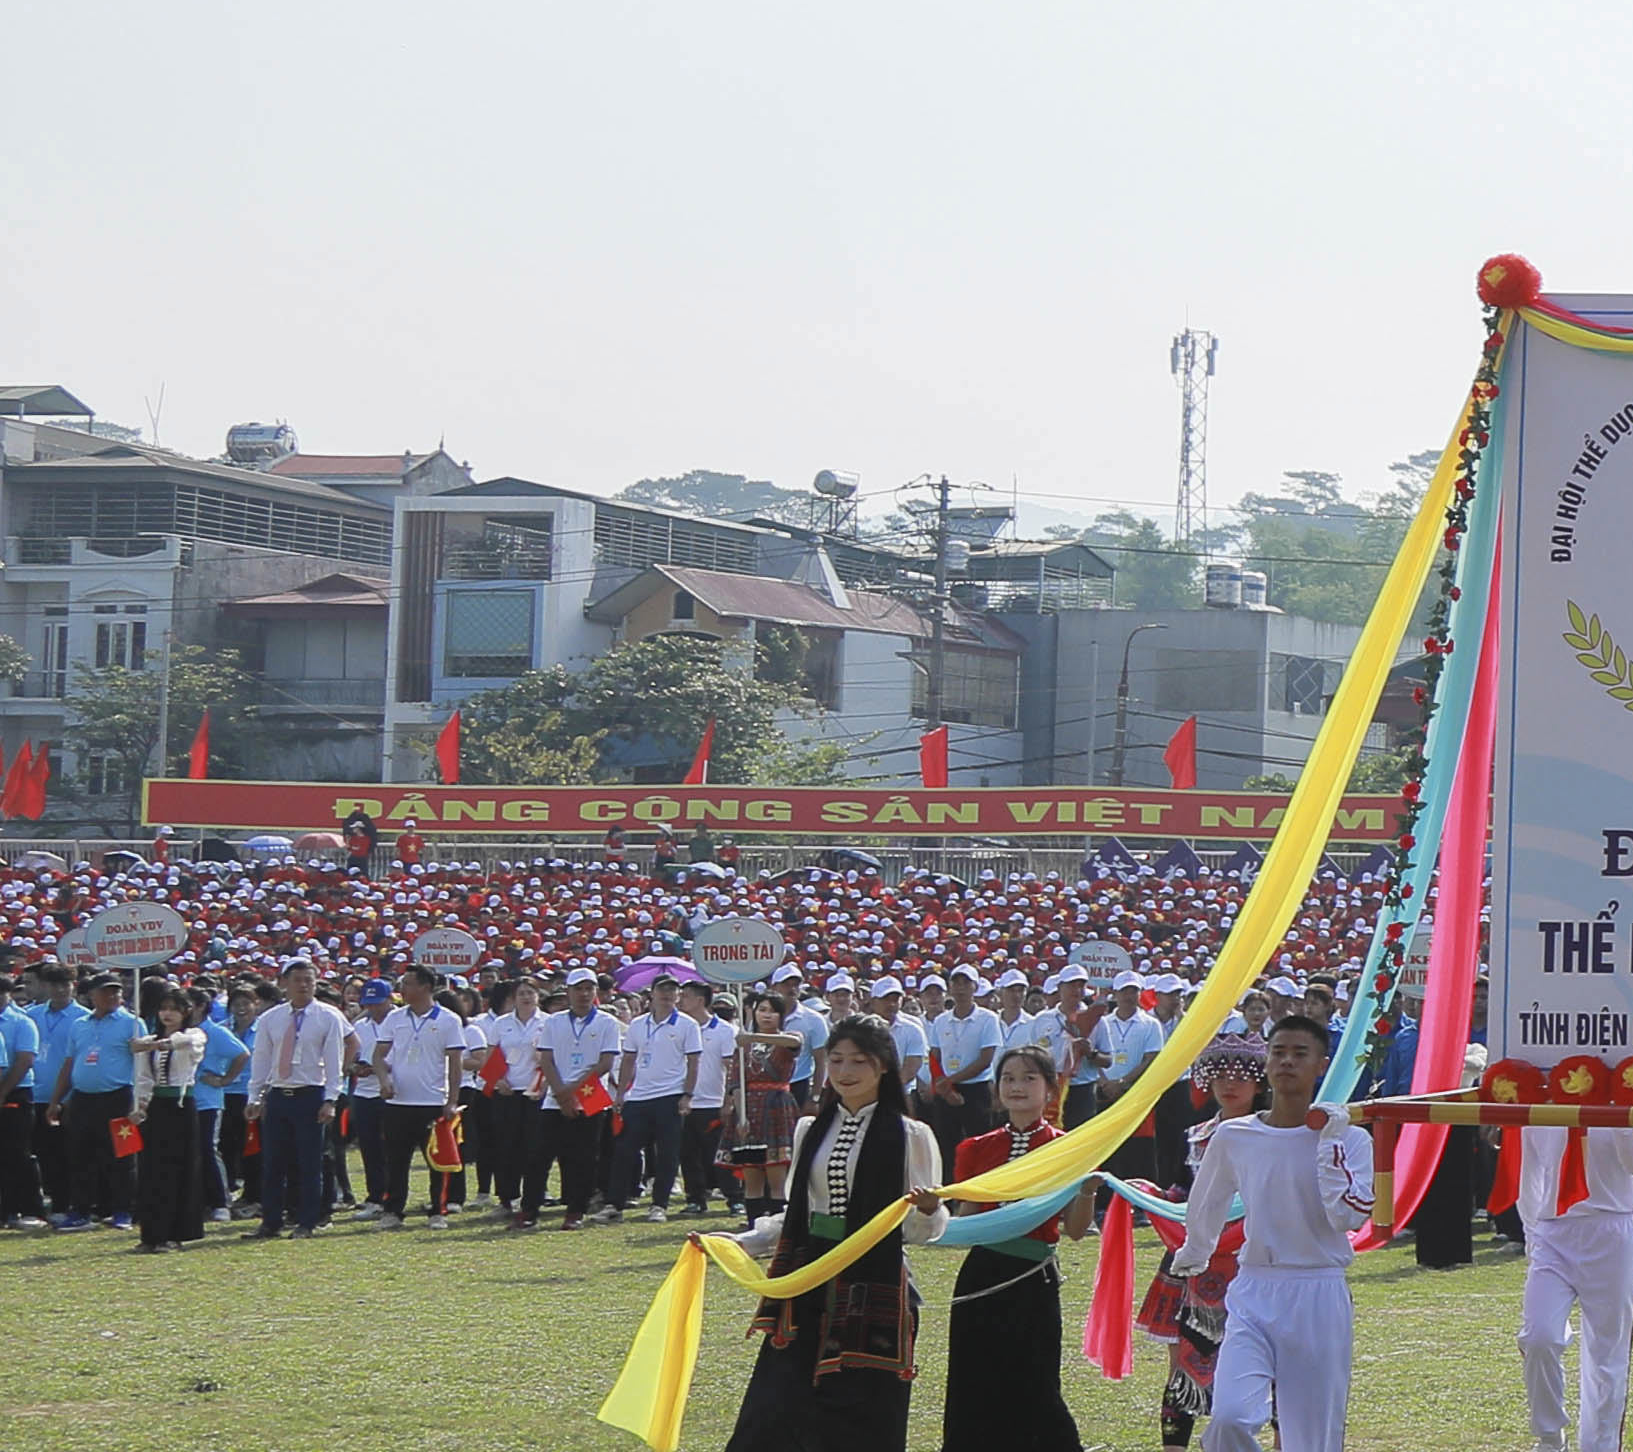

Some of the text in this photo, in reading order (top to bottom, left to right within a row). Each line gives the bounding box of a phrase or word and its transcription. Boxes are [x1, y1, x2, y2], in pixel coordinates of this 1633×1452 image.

[1573, 432, 1609, 482] THỂ
[1555, 481, 1587, 521] HỘI
[1550, 525, 1577, 563] ĐẠI
[332, 793, 550, 822] ĐẢNG
[579, 795, 793, 825] CỘNG
[821, 795, 979, 824] SẢN
[1006, 797, 1173, 828] VIỆT
[702, 940, 774, 964] TRỌNG TÀI
[1538, 900, 1619, 975] THỂ
[1519, 1001, 1567, 1046] TỈNH
[1576, 1007, 1628, 1054] ĐIỆN
